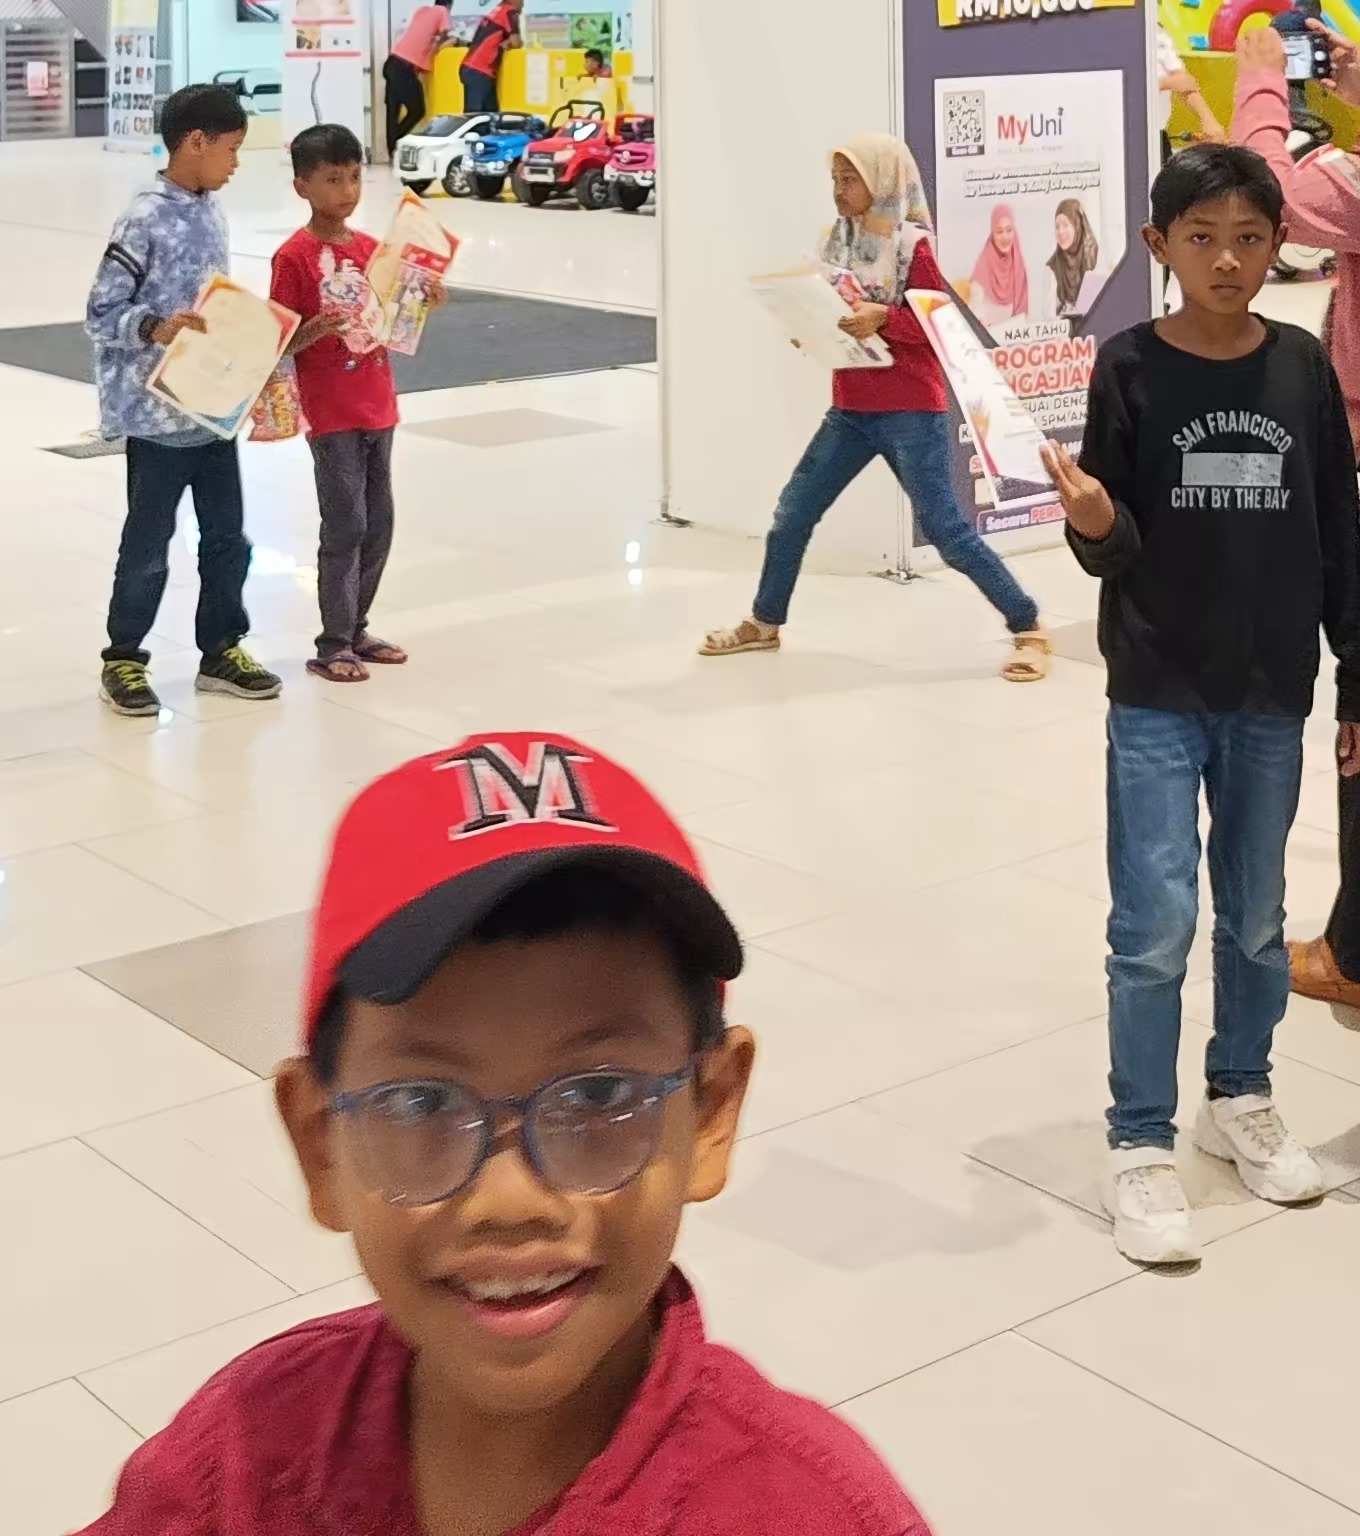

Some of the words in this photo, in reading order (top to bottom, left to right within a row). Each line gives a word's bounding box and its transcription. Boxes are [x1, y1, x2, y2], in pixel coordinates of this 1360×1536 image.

[997, 107, 1064, 144] MyUni
[1004, 328, 1030, 340] NAK
[1035, 324, 1068, 338] TAHU
[994, 339, 1092, 370] ROGRAM
[1172, 421, 1207, 453] SAN
[1206, 410, 1293, 454] FRANCISCO
[1171, 487, 1205, 509] CITY
[1211, 487, 1230, 509] BY
[1235, 487, 1262, 510] THE
[1264, 488, 1291, 510] BAY
[434, 741, 620, 841] M
